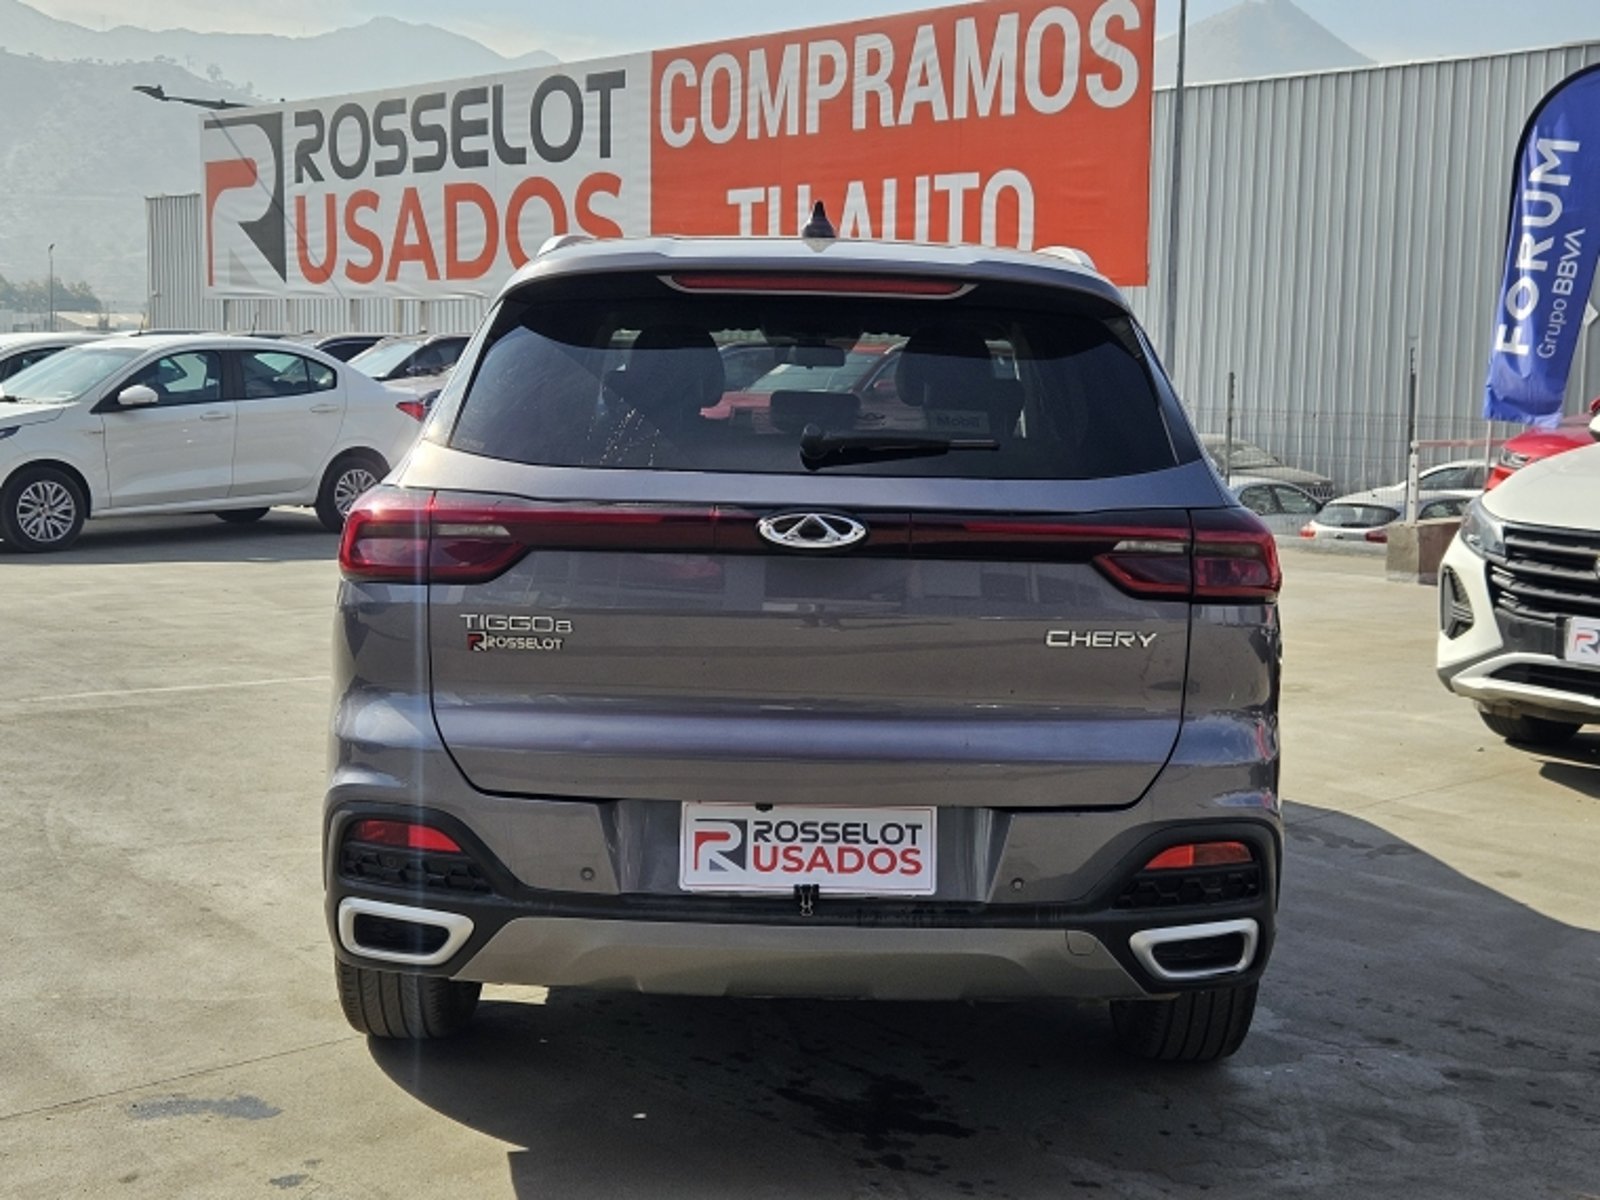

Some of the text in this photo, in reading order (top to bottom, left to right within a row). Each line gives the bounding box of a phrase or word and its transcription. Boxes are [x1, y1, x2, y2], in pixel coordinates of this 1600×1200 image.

[294, 70, 626, 184] ROSSELOT
[660, 0, 1141, 148] COMPRAMOS
[294, 171, 624, 284] USADOS
[1495, 138, 1580, 357] FORUM
[1537, 228, 1586, 359] Grupo BBVA
[487, 635, 563, 650] ROSSELOT
[1046, 630, 1157, 648] CHERY
[753, 820, 923, 846] ROSSELOT
[753, 846, 923, 876] USADOS
